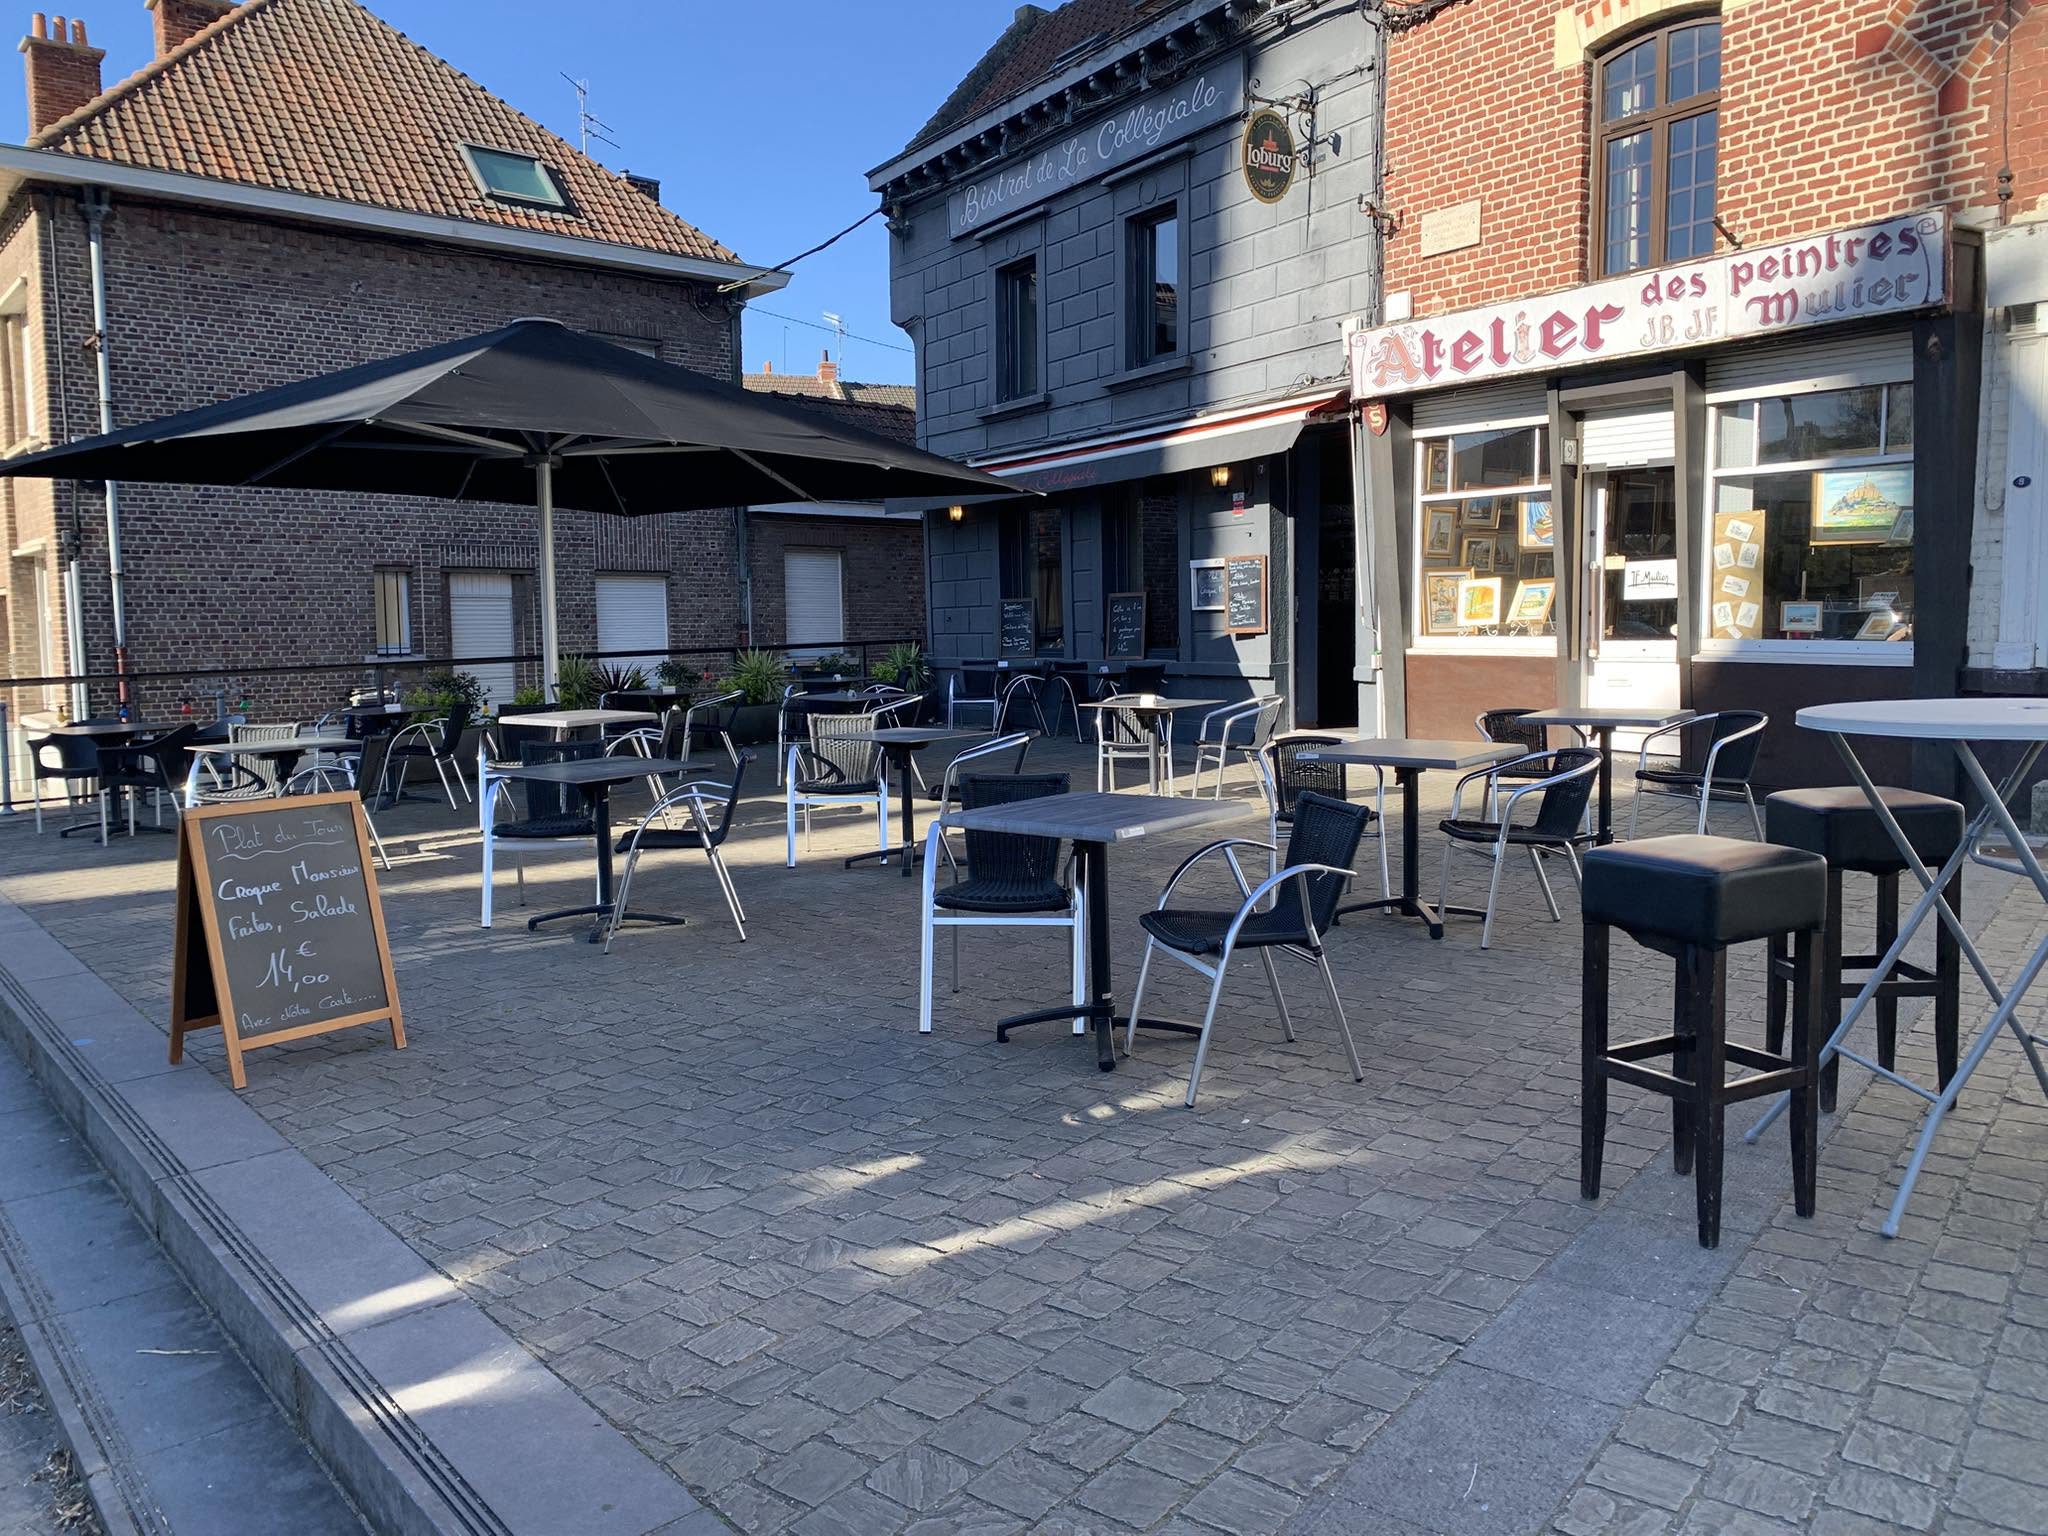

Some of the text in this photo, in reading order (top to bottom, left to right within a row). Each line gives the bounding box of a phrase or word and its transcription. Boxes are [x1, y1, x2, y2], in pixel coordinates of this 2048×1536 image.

[961, 77, 1224, 225] Bistrot de La Collégiale
[1246, 144, 1292, 173] Loburg
[1367, 226, 1919, 388] Atelier des peintres
[1746, 272, 1920, 327] Mulier
[1567, 445, 1573, 459] 9
[212, 819, 344, 853] Plat du Jour
[218, 860, 359, 905] Croque Monsieur
[290, 894, 359, 923] Salade
[296, 941, 317, 957] €
[242, 1013, 272, 1030] Avec
